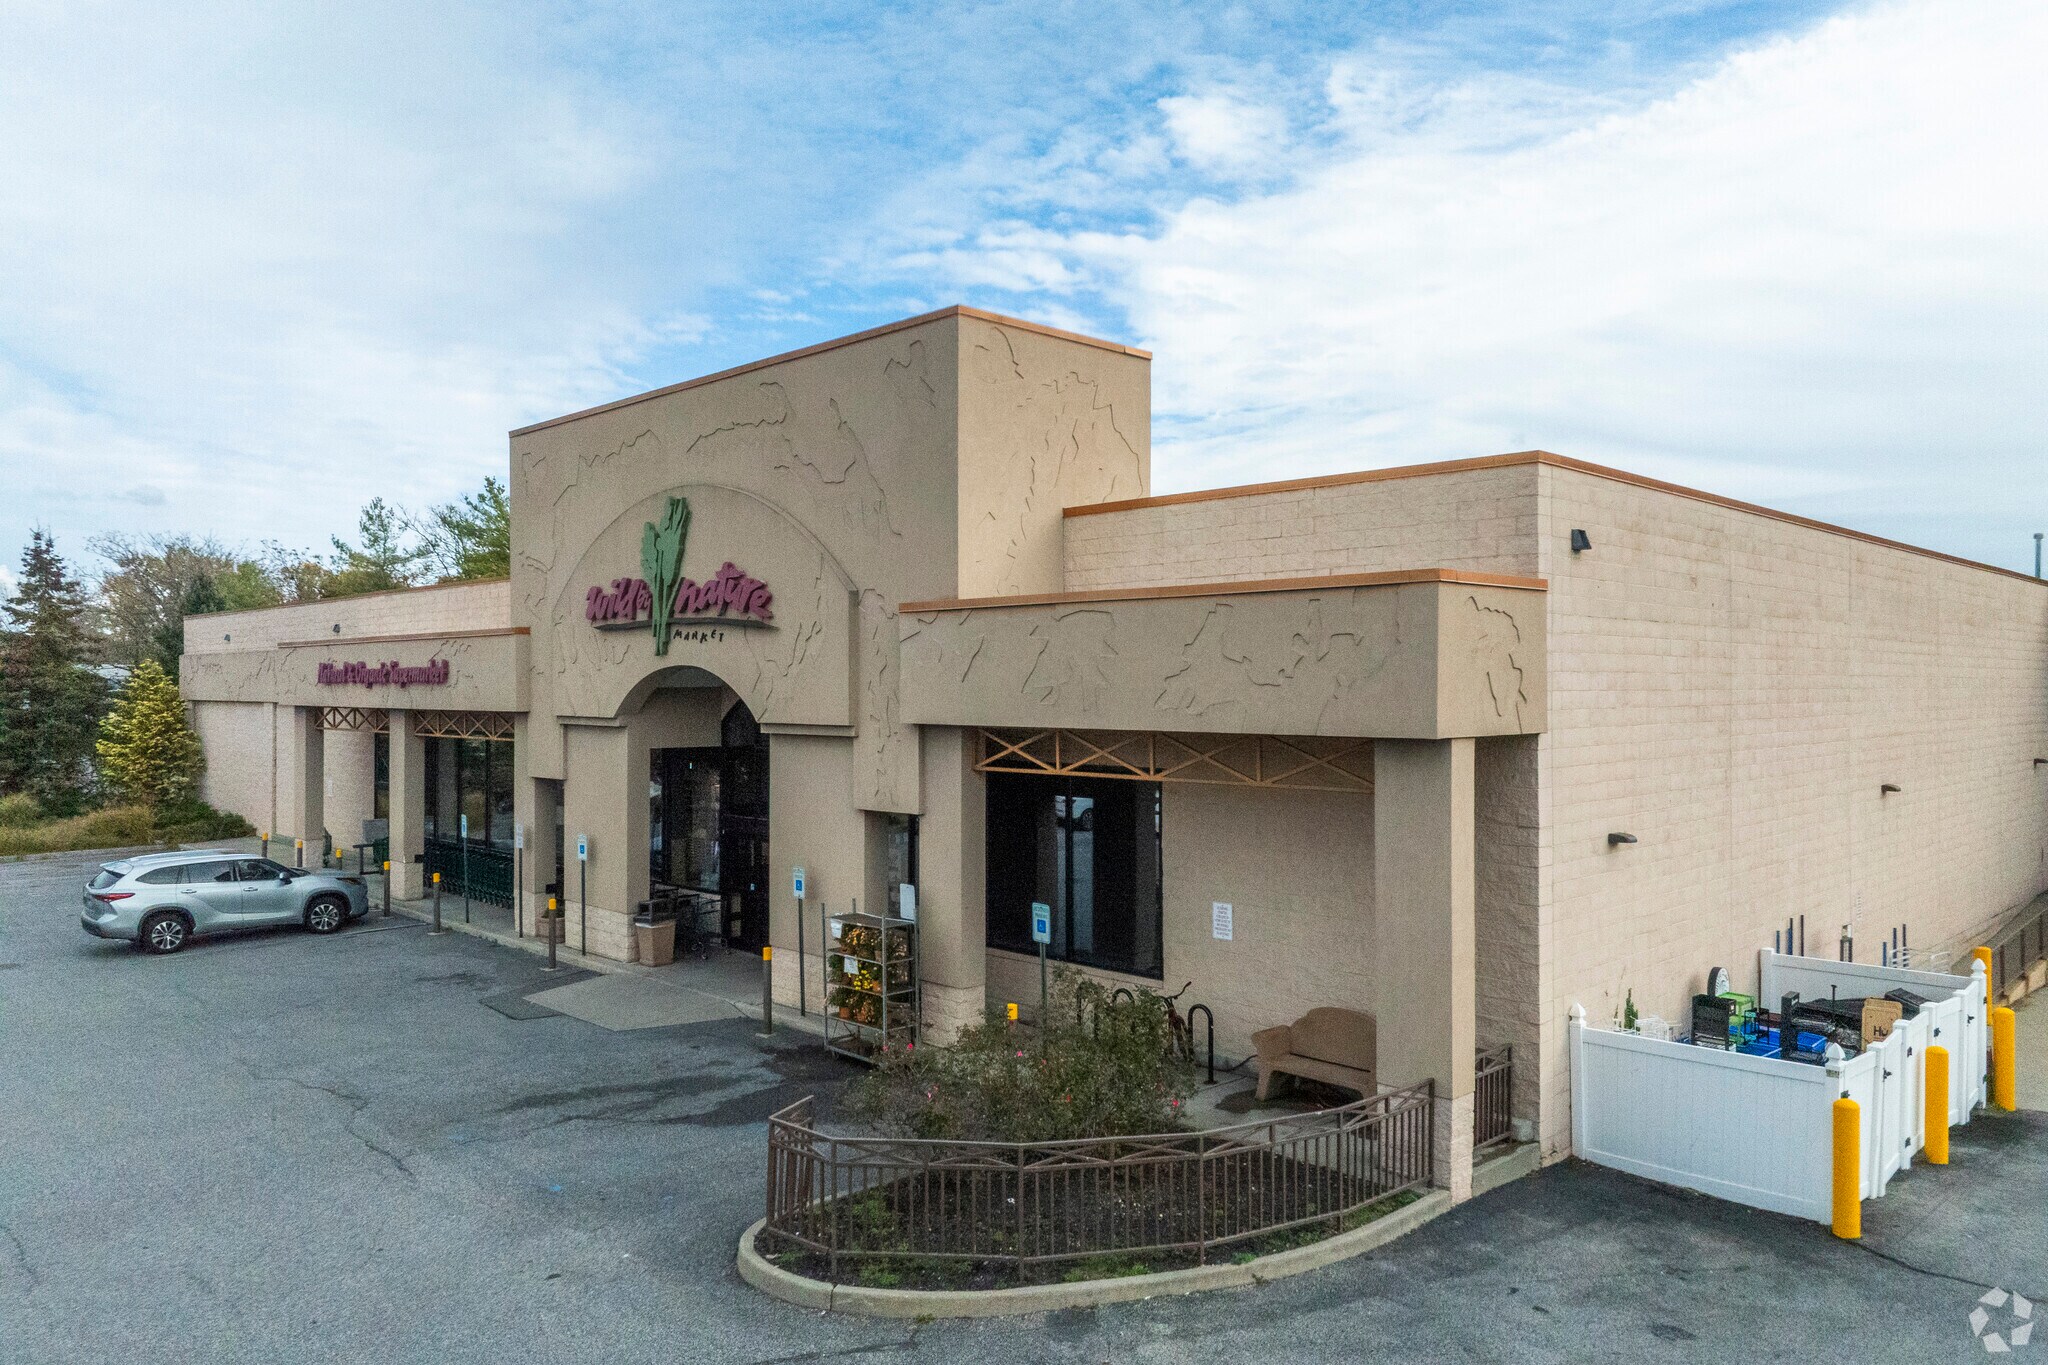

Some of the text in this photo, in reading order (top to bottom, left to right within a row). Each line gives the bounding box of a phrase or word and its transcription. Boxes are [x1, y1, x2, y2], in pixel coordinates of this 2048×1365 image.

[586, 577, 642, 621] wild
[673, 562, 775, 620] nature
[673, 629, 724, 643] MARKET
